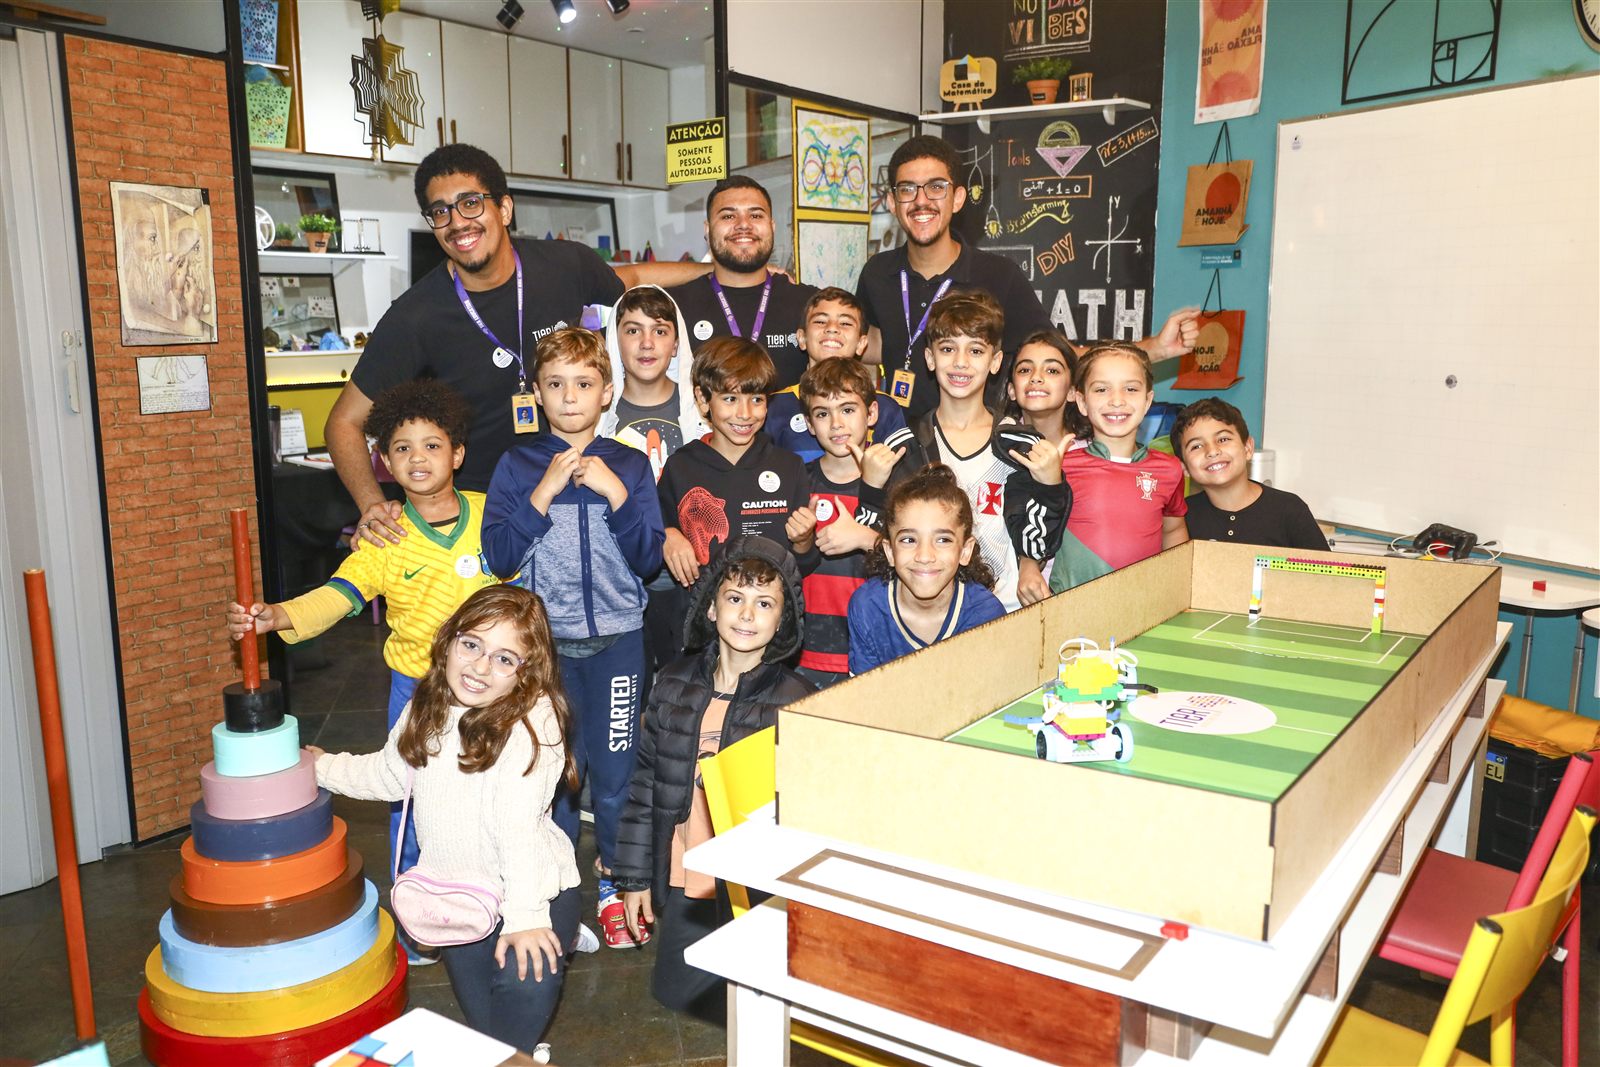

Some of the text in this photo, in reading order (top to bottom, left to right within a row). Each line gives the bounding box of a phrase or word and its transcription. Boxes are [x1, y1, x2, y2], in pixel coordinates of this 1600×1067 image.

[1048, 6, 1088, 39] BES
[974, 80, 985, 88] da
[943, 88, 992, 97] Matemática
[669, 121, 721, 140] ATENÇÃO
[678, 146, 713, 157] SOMENTE
[680, 156, 711, 167] PESSOAS
[670, 166, 723, 178] AUTORIZADAS
[1037, 232, 1076, 276] DIY
[1034, 289, 1147, 342] ATH
[742, 500, 787, 509] CAUTION
[609, 675, 631, 752] STARTED
